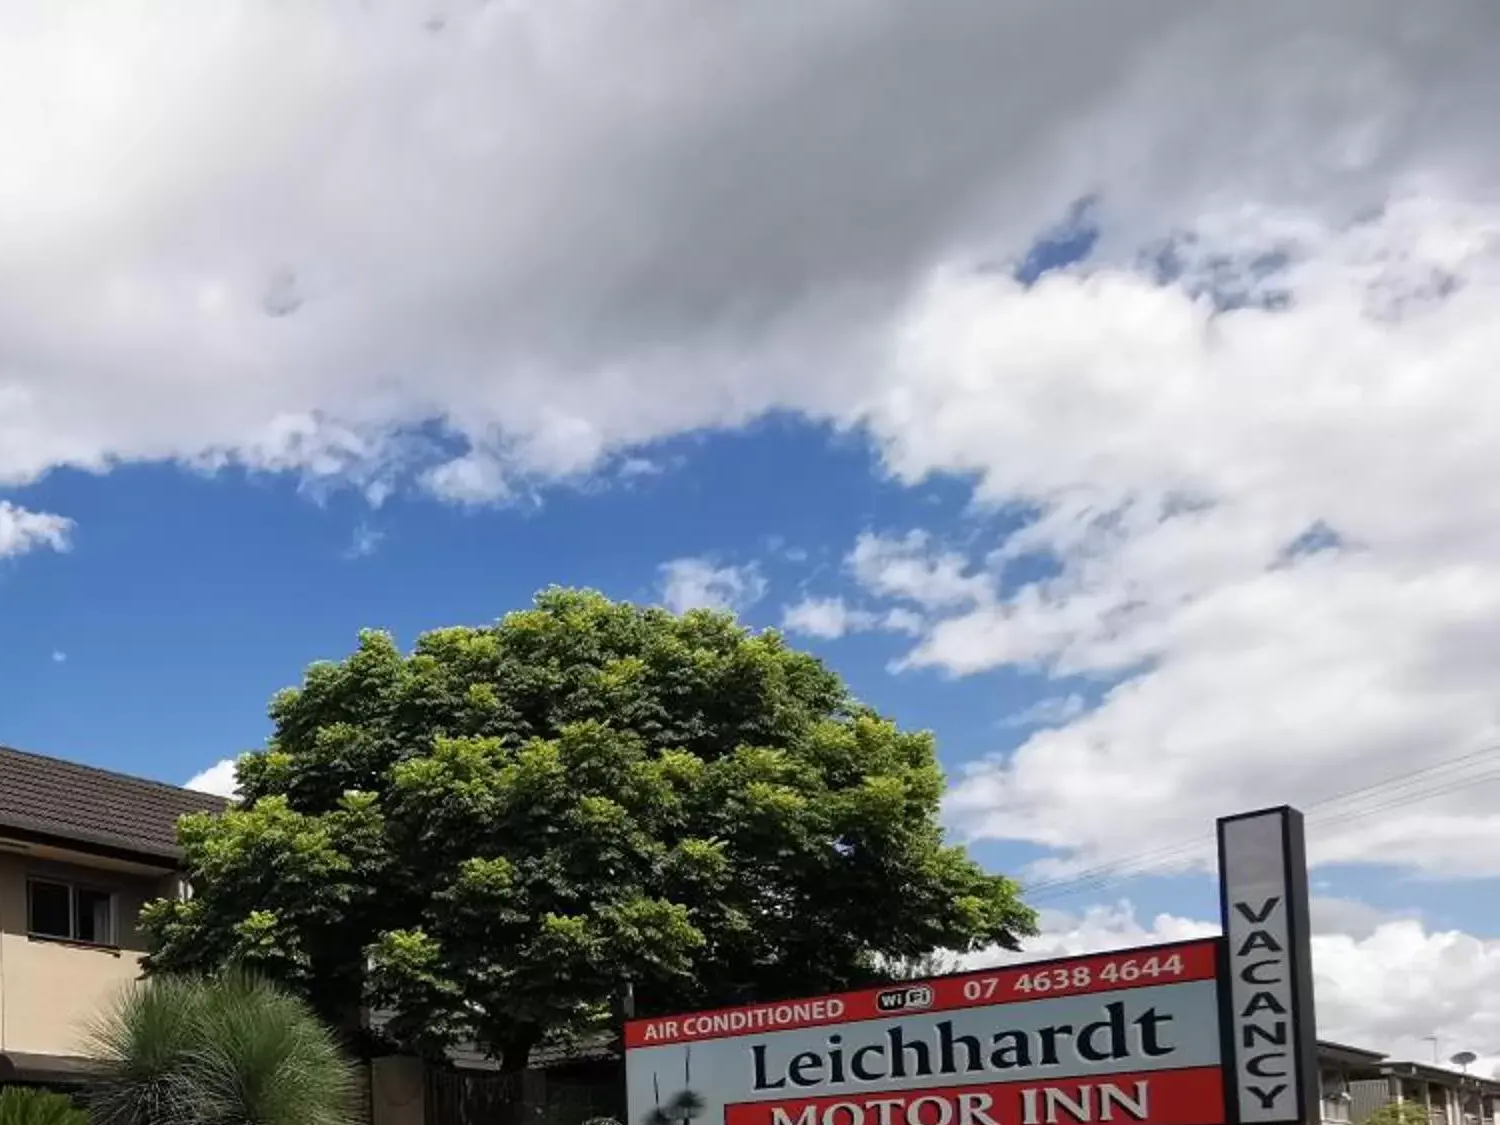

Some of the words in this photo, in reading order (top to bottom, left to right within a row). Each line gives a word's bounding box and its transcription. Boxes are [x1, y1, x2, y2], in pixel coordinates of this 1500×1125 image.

[963, 978, 999, 1000] 07
[1013, 966, 1091, 993] 4638
[1100, 954, 1184, 983] 4644
[644, 1020, 678, 1041] AIR
[683, 999, 845, 1035] CONDITIONED
[1233, 897, 1288, 1109] VACANCY
[752, 1001, 1177, 1091] Leichhardt
[1020, 1080, 1149, 1125] INN
